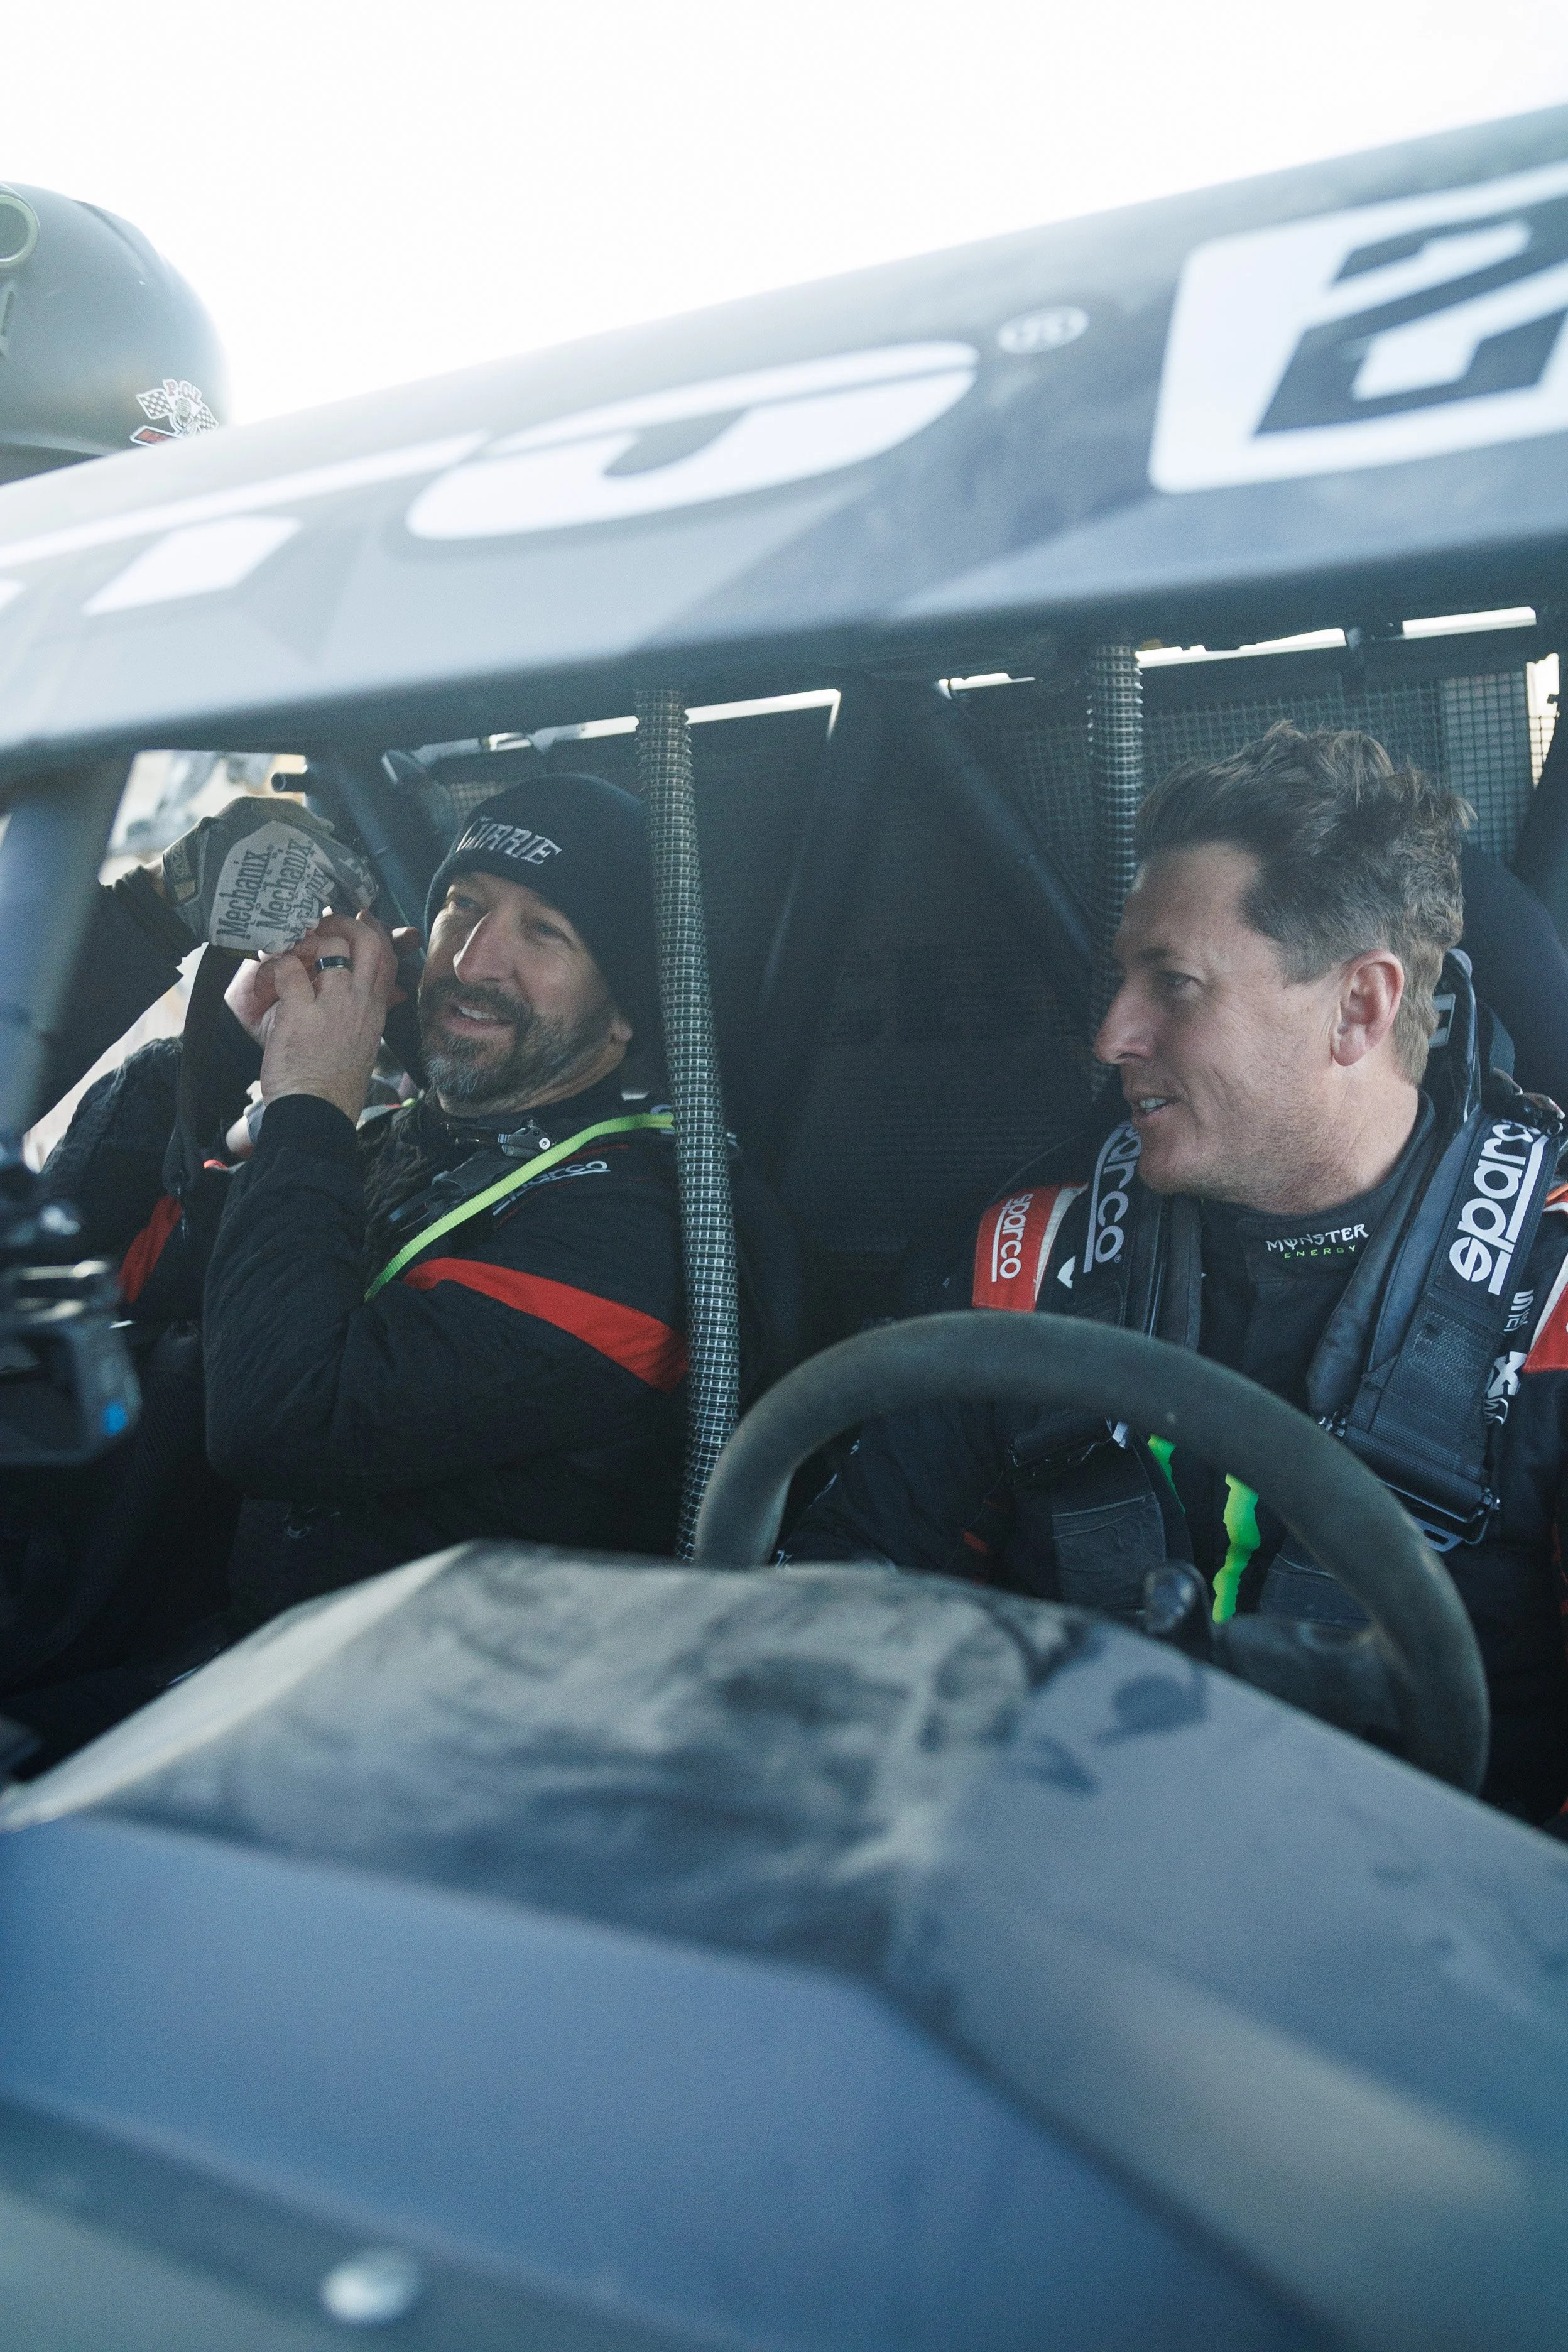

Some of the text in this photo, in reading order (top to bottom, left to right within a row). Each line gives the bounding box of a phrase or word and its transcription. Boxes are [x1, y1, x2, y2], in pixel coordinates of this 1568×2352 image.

[217, 849, 271, 939] Mechanix
[991, 1193, 1034, 1283] sparco
[1265, 1224, 1369, 1252] MONSTER
[1284, 1245, 1356, 1258] ENERGY
[1449, 1121, 1549, 1295] sparc
